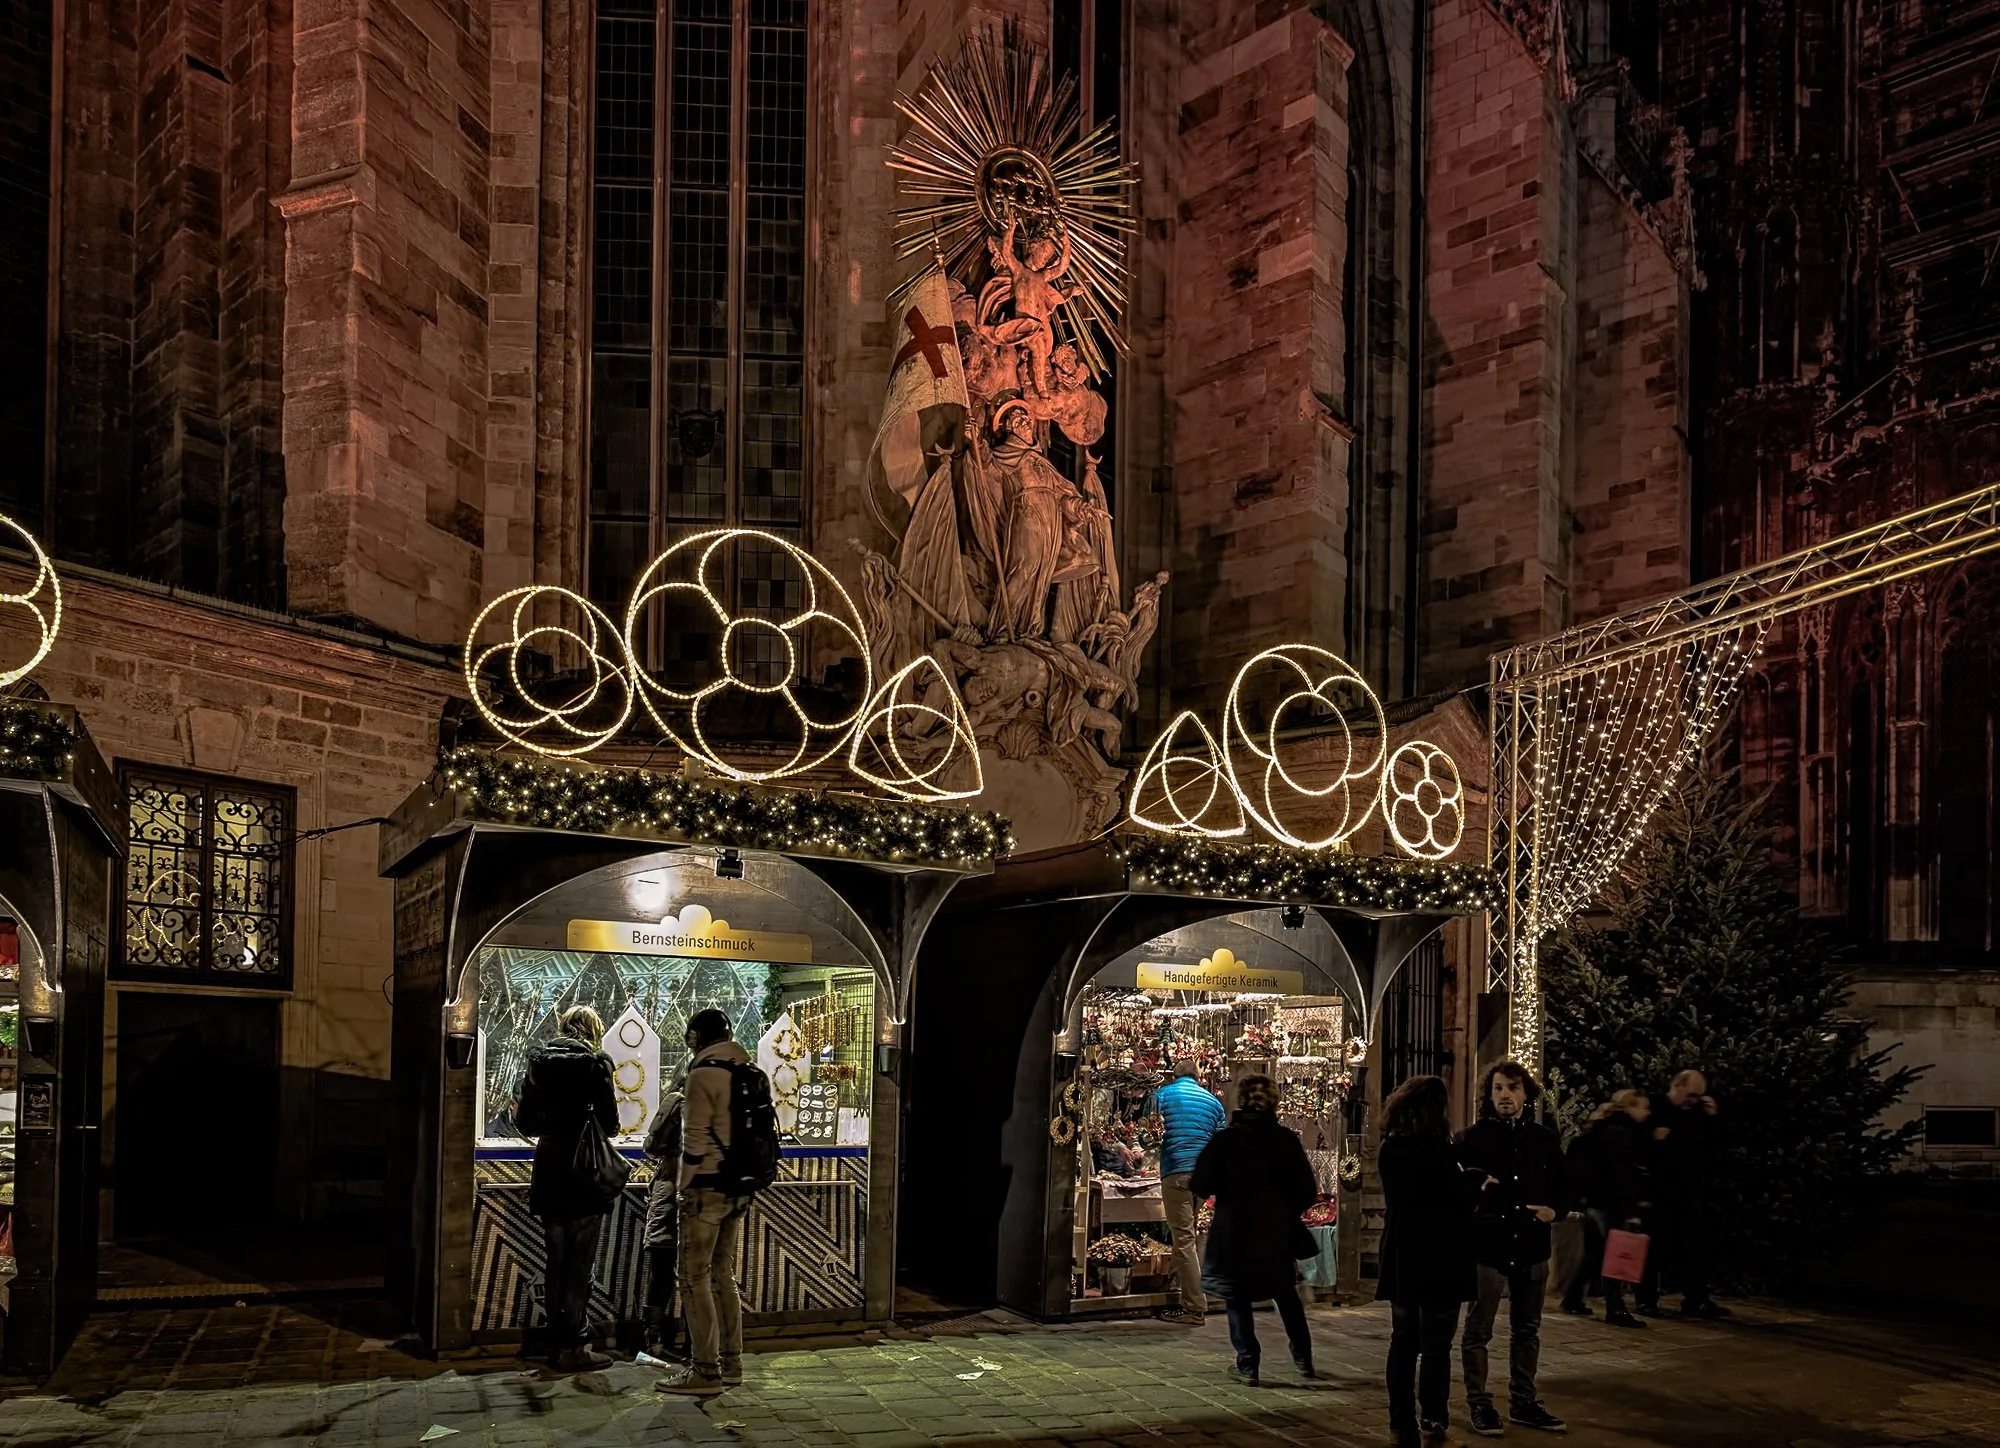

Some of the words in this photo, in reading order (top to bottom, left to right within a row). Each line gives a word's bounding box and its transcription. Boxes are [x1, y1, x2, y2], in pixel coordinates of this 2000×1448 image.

[632, 930, 755, 952] Bernsteinschmuck
[1164, 970, 1237, 988] Handgefertigte
[1239, 973, 1278, 988] Keramik
